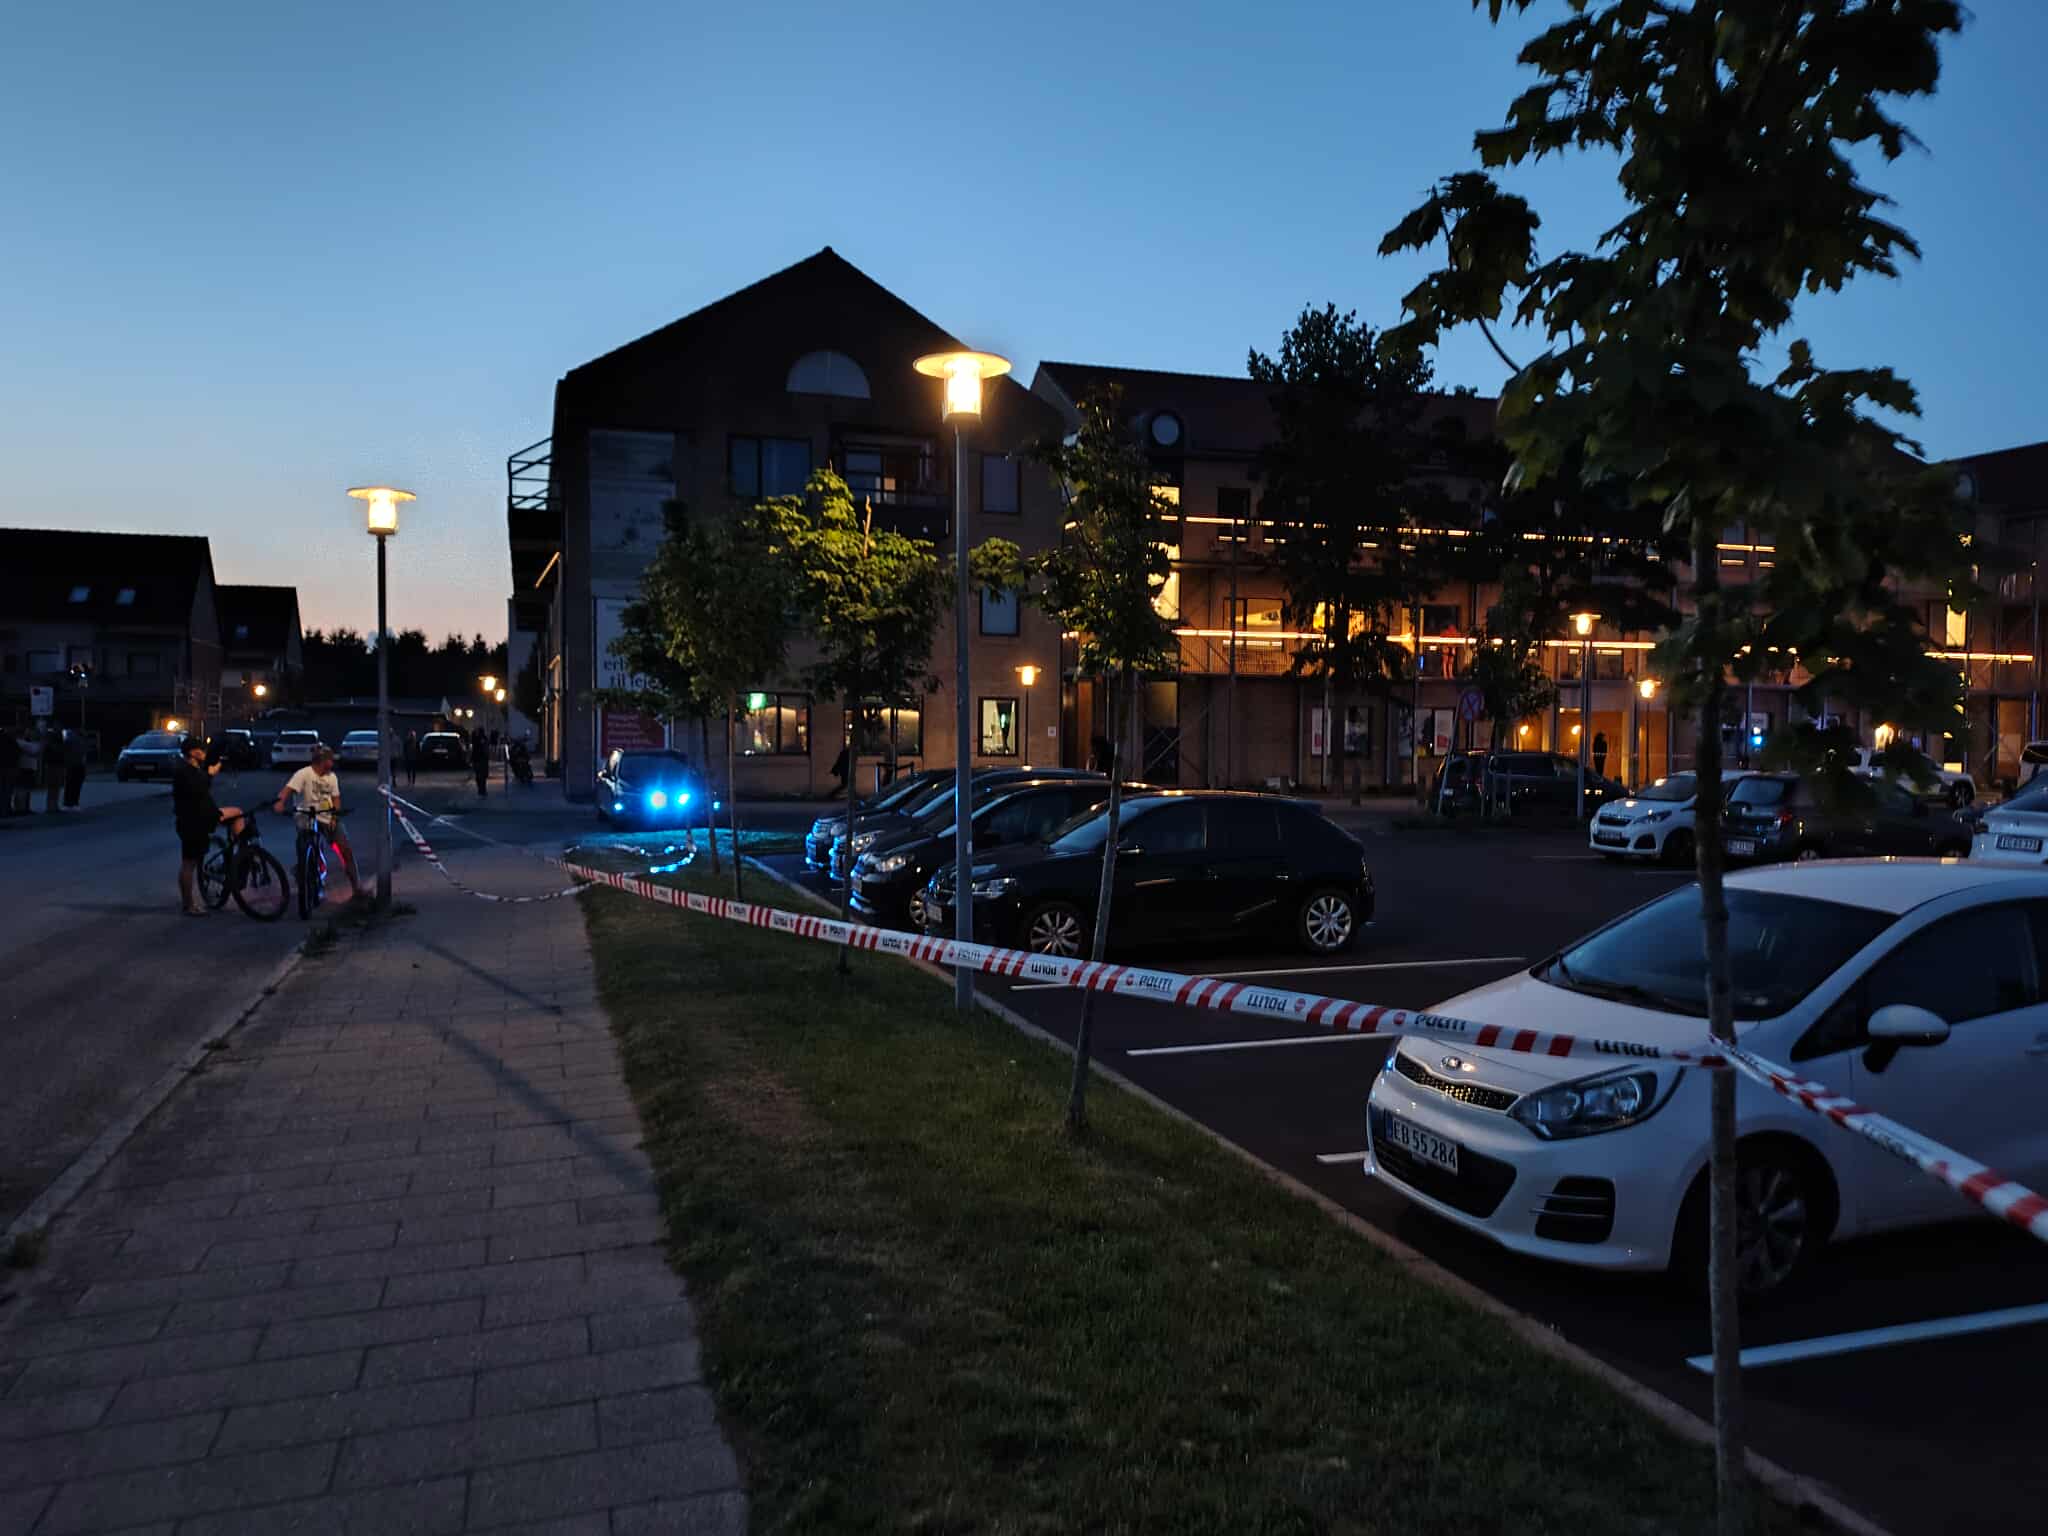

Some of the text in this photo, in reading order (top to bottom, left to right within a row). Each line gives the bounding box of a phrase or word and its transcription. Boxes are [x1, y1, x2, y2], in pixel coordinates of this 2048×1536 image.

[1138, 974, 1174, 992] POLITI
[1247, 993, 1289, 1012] POLITI
[1414, 1014, 1467, 1031] POLITI
[1413, 1129, 1428, 1154] 55
[1431, 1137, 1457, 1169] 284
